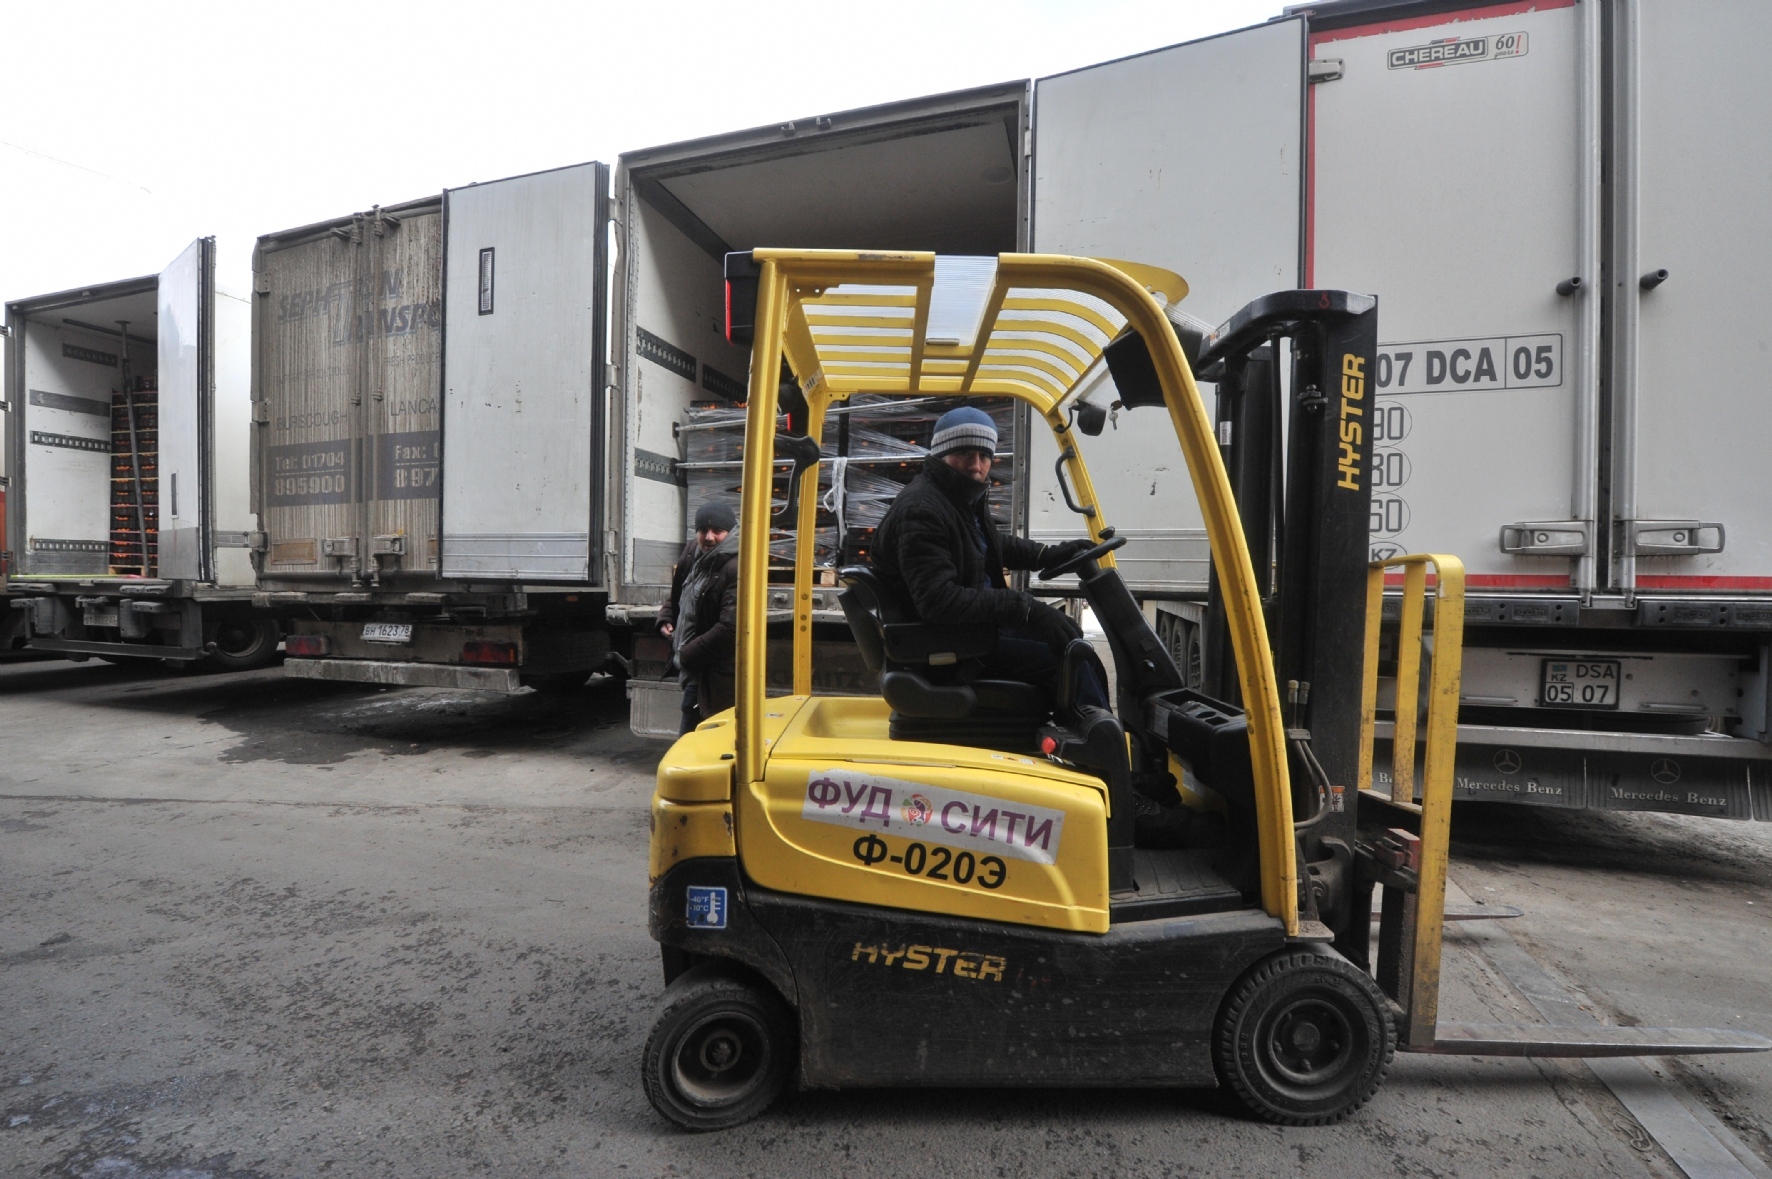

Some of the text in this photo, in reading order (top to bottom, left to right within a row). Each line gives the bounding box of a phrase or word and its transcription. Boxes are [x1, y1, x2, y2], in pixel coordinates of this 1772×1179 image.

[1392, 41, 1483, 66] CHEREAU
[1426, 347, 1497, 385] DCA
[1513, 345, 1554, 380] 05
[1337, 353, 1365, 491] HYSTER
[302, 451, 345, 469] 01704
[394, 444, 427, 460] Fax:
[275, 474, 346, 496] 895900
[378, 624, 399, 637] 1623
[400, 625, 410, 634] 78
[1551, 663, 1615, 682] KZ DSA
[1547, 685, 1609, 704] 05 07
[1456, 777, 1563, 796] Mercedes Benz
[1610, 787, 1727, 806] Mercedes Benz
[808, 776, 1054, 851] ФУД СИТИ
[853, 834, 1007, 889] Ф-020Э
[852, 942, 1007, 982] HYSTER
